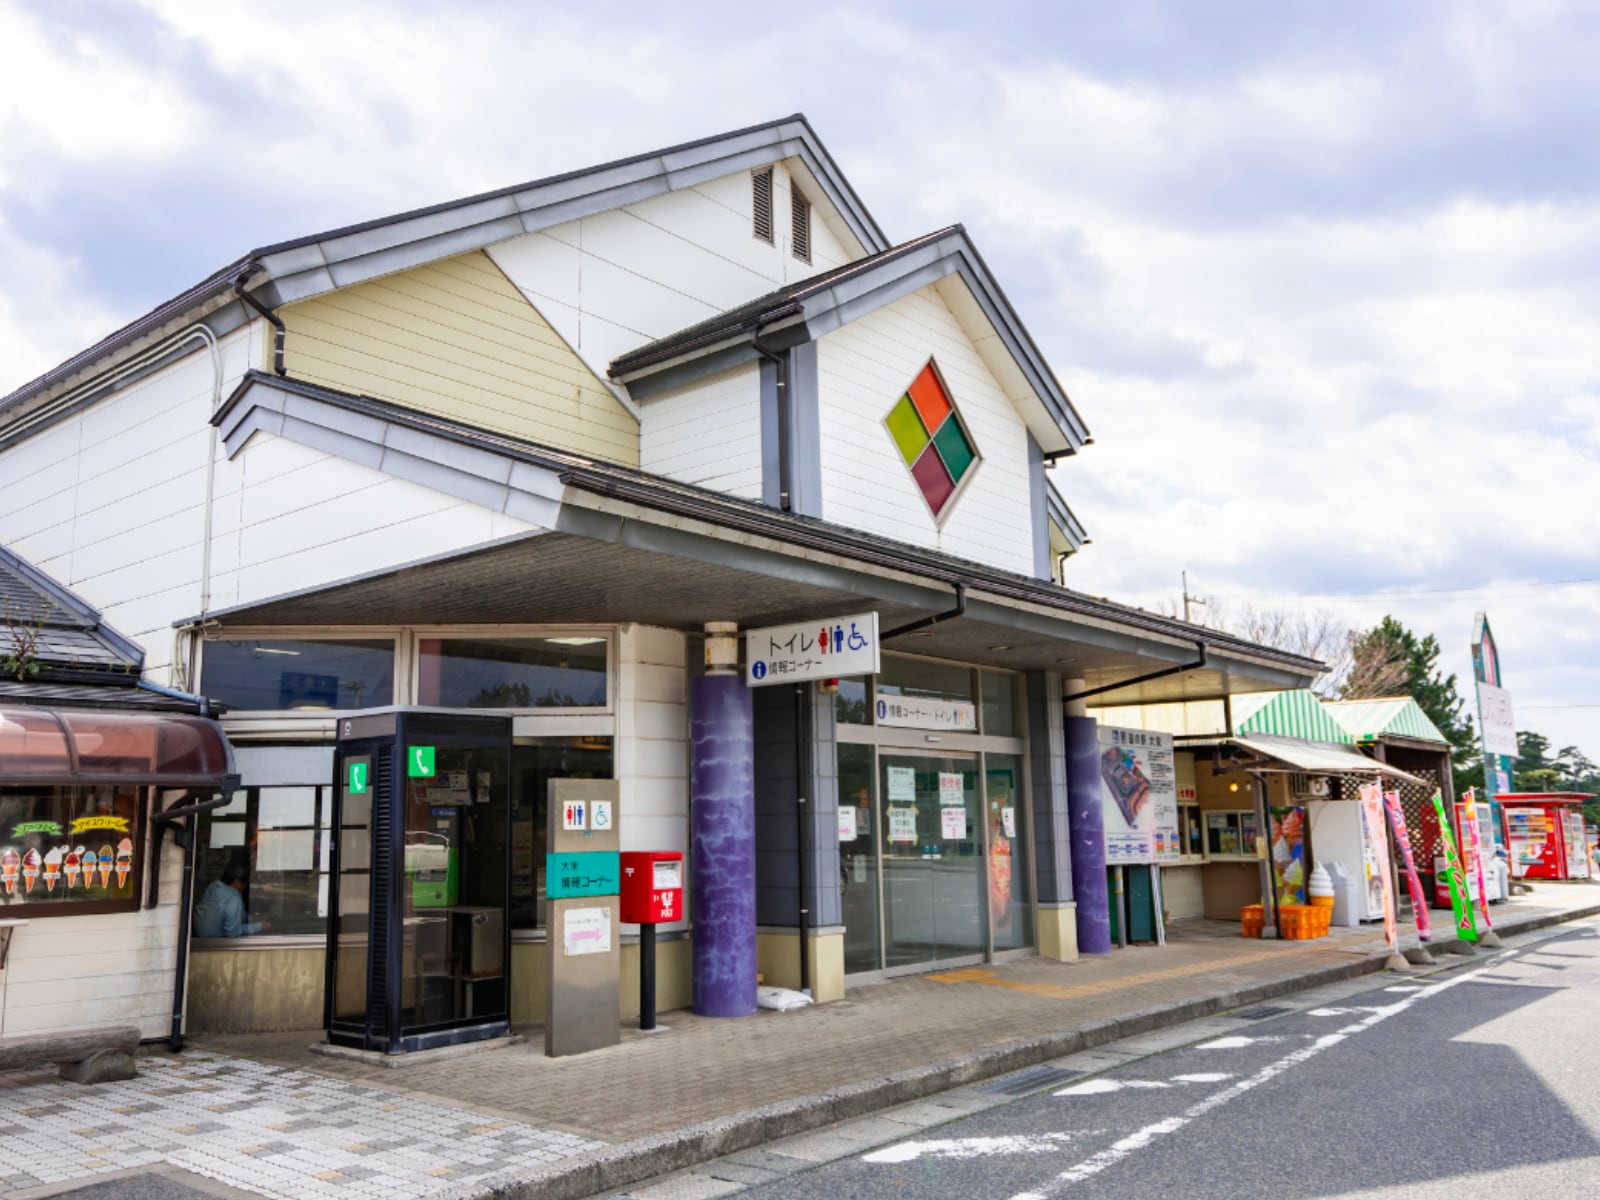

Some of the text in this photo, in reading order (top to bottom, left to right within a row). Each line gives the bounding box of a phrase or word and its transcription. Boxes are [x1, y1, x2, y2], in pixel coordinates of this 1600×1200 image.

[770, 632, 814, 656] トイレ
[769, 659, 822, 675] 情報コーナー
[561, 876, 613, 889] 情報コーナー
